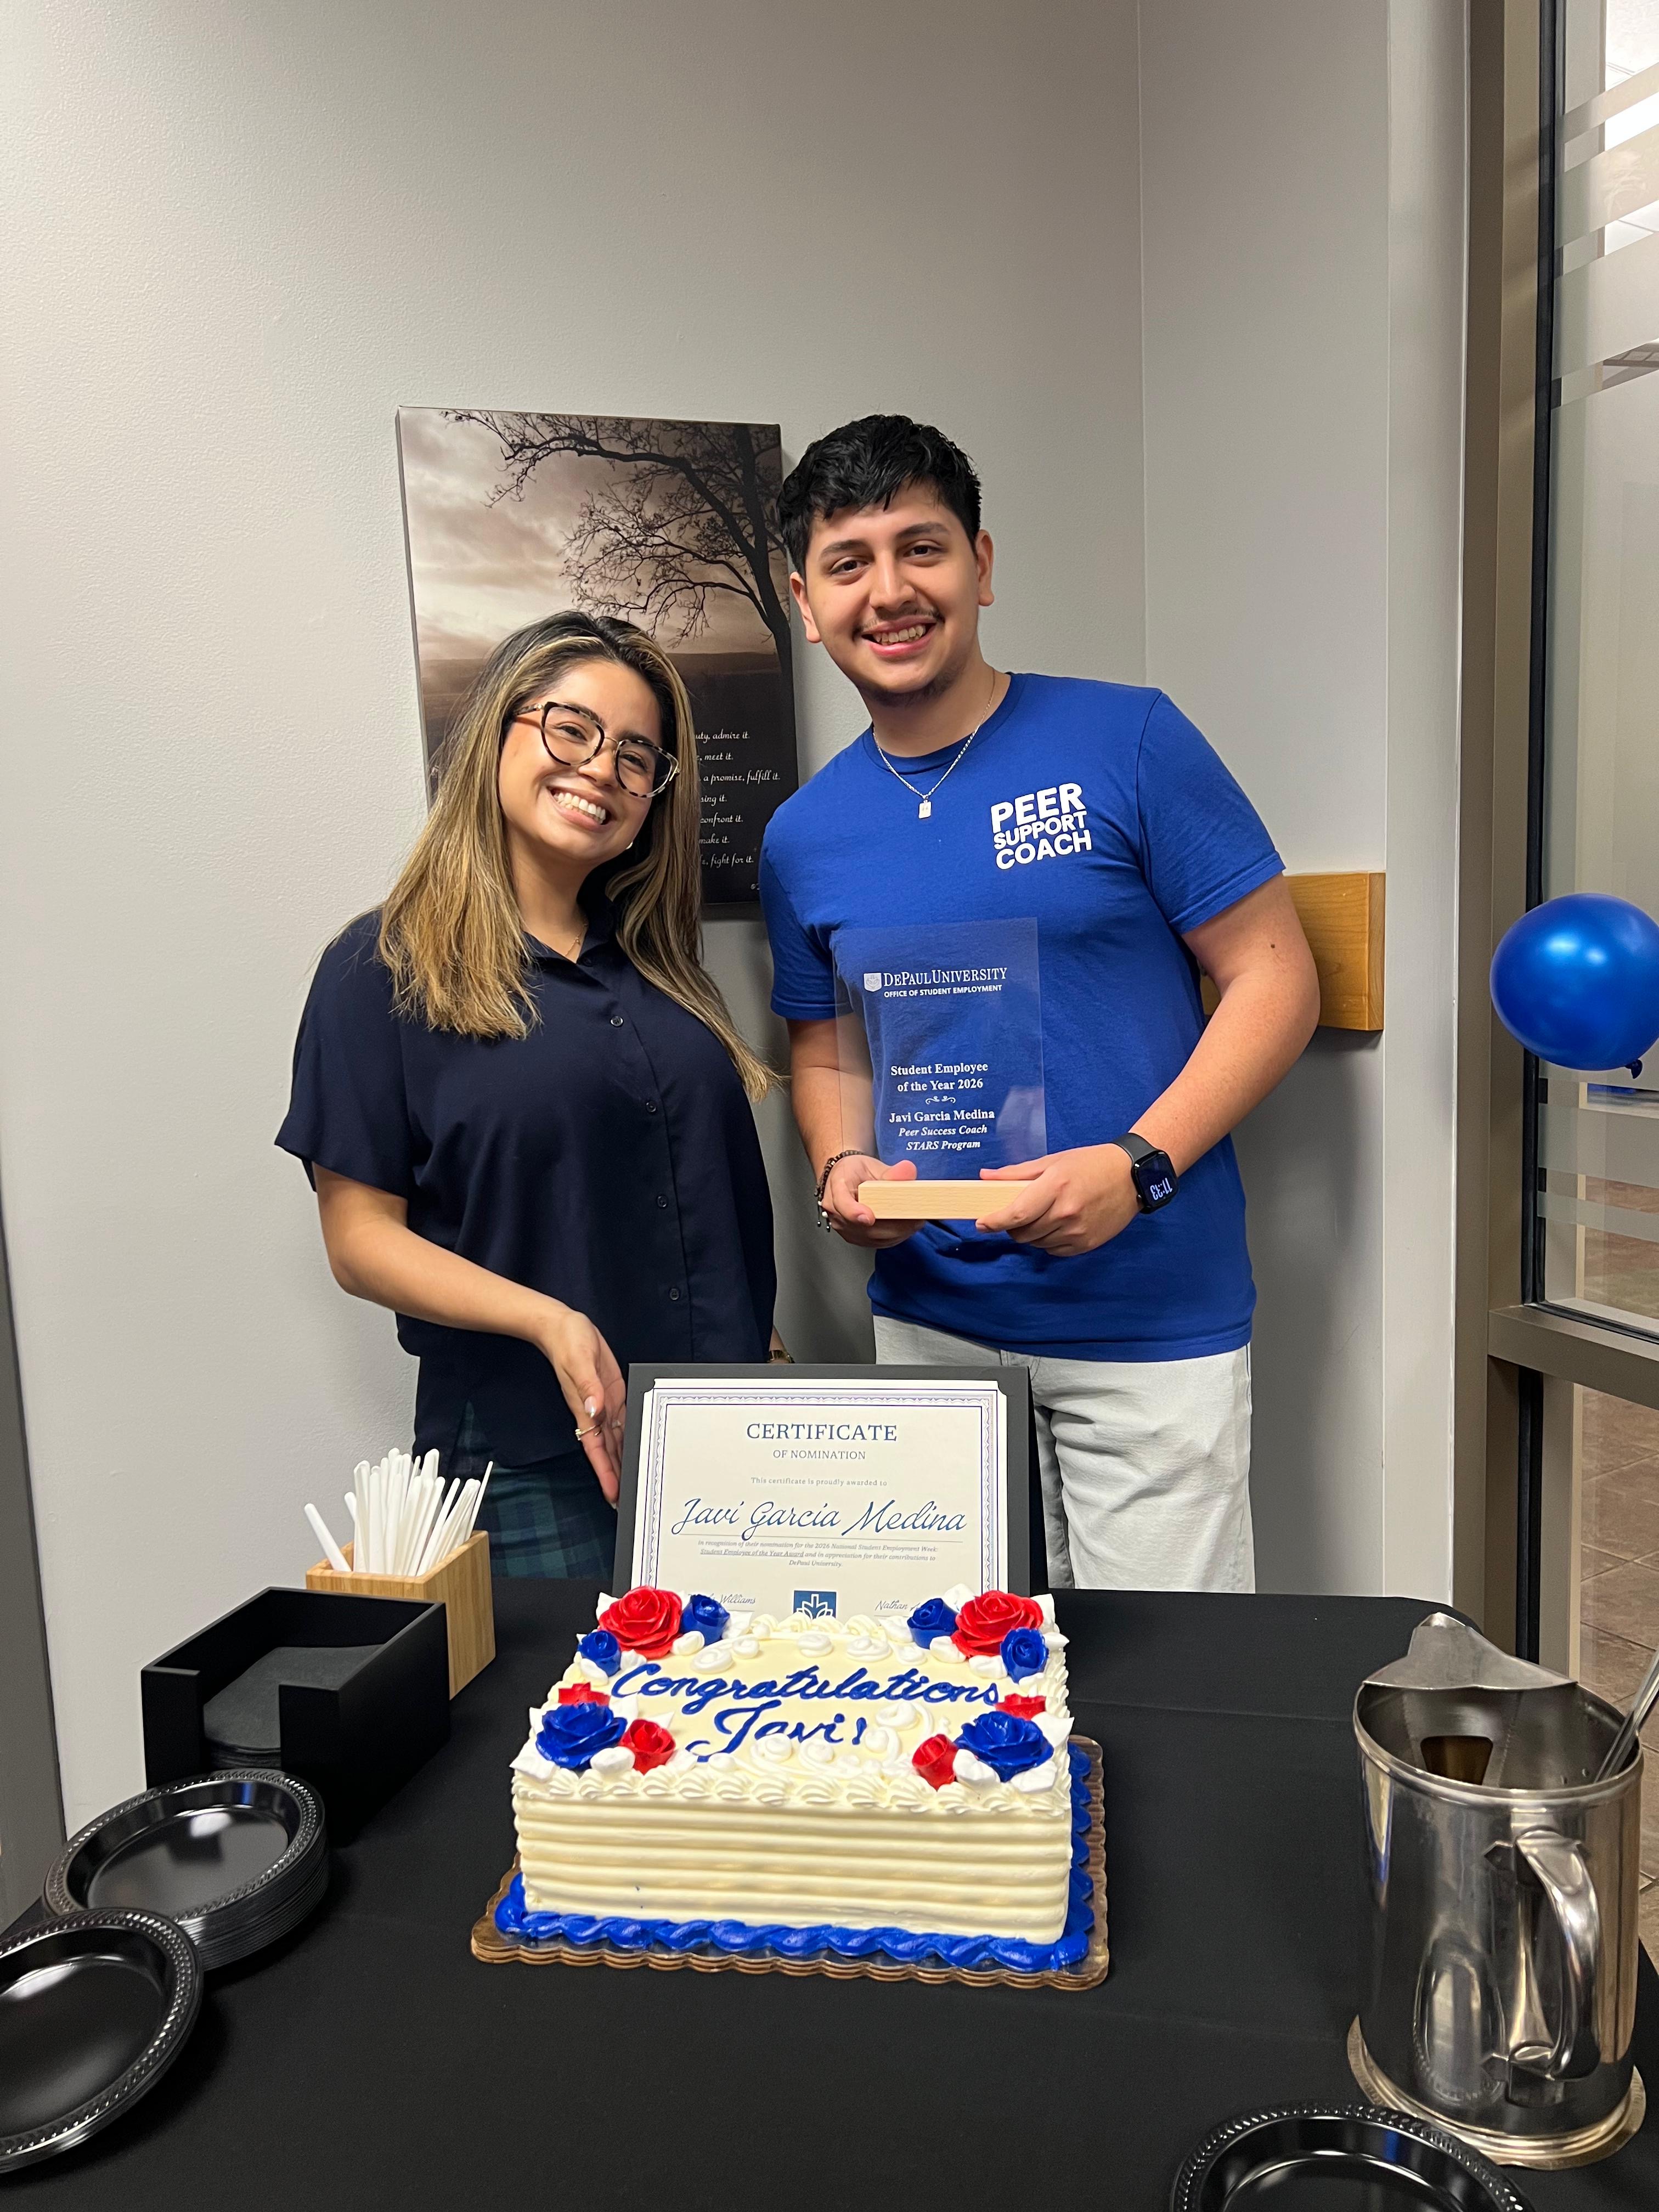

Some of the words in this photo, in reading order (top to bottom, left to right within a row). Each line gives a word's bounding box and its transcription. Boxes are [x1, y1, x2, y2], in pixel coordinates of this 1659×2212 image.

[696, 731, 710, 743] uty,
[713, 729, 740, 739] admire
[704, 752, 723, 760] meet
[725, 752, 733, 760] it.
[710, 774, 745, 785] promise,
[747, 770, 771, 785] fulfill
[719, 794, 727, 802] it.
[990, 782, 1086, 833] PEER
[700, 812, 733, 827] confront
[994, 810, 1087, 850] SUPPORT
[698, 833, 720, 844] make
[996, 830, 1092, 870] COACH
[710, 853, 730, 868] fight
[731, 853, 743, 867] for
[919, 988, 951, 996] STUDENT
[953, 984, 1002, 994] EMPLOYMENT
[890, 1065, 932, 1076] Student
[935, 1063, 988, 1075] Employee
[897, 1081, 909, 1092] of
[911, 1081, 927, 1091] the
[930, 1080, 955, 1090] Year
[958, 1078, 984, 1089] 2026
[889, 1112, 911, 1123] Javi
[914, 1111, 951, 1122] Garcia
[953, 1109, 995, 1120] Medina
[898, 1127, 919, 1137] Peer
[921, 1126, 956, 1136] Success
[958, 1125, 988, 1134] Coach
[906, 1141, 939, 1150] STARS
[941, 1140, 981, 1150] Program
[746, 1423, 898, 1441] CERTIFICATE
[772, 1449, 788, 1459] OF
[791, 1449, 866, 1460] NOMINATION
[672, 1498, 744, 1535] Javi
[741, 1501, 842, 1541] Garcia
[841, 1499, 968, 1536] Medina
[719, 1594, 756, 1604] Williams
[874, 1599, 908, 1611] Nathan
[611, 1662, 999, 1715] Congratulations
[685, 1700, 867, 1763] Javi!
